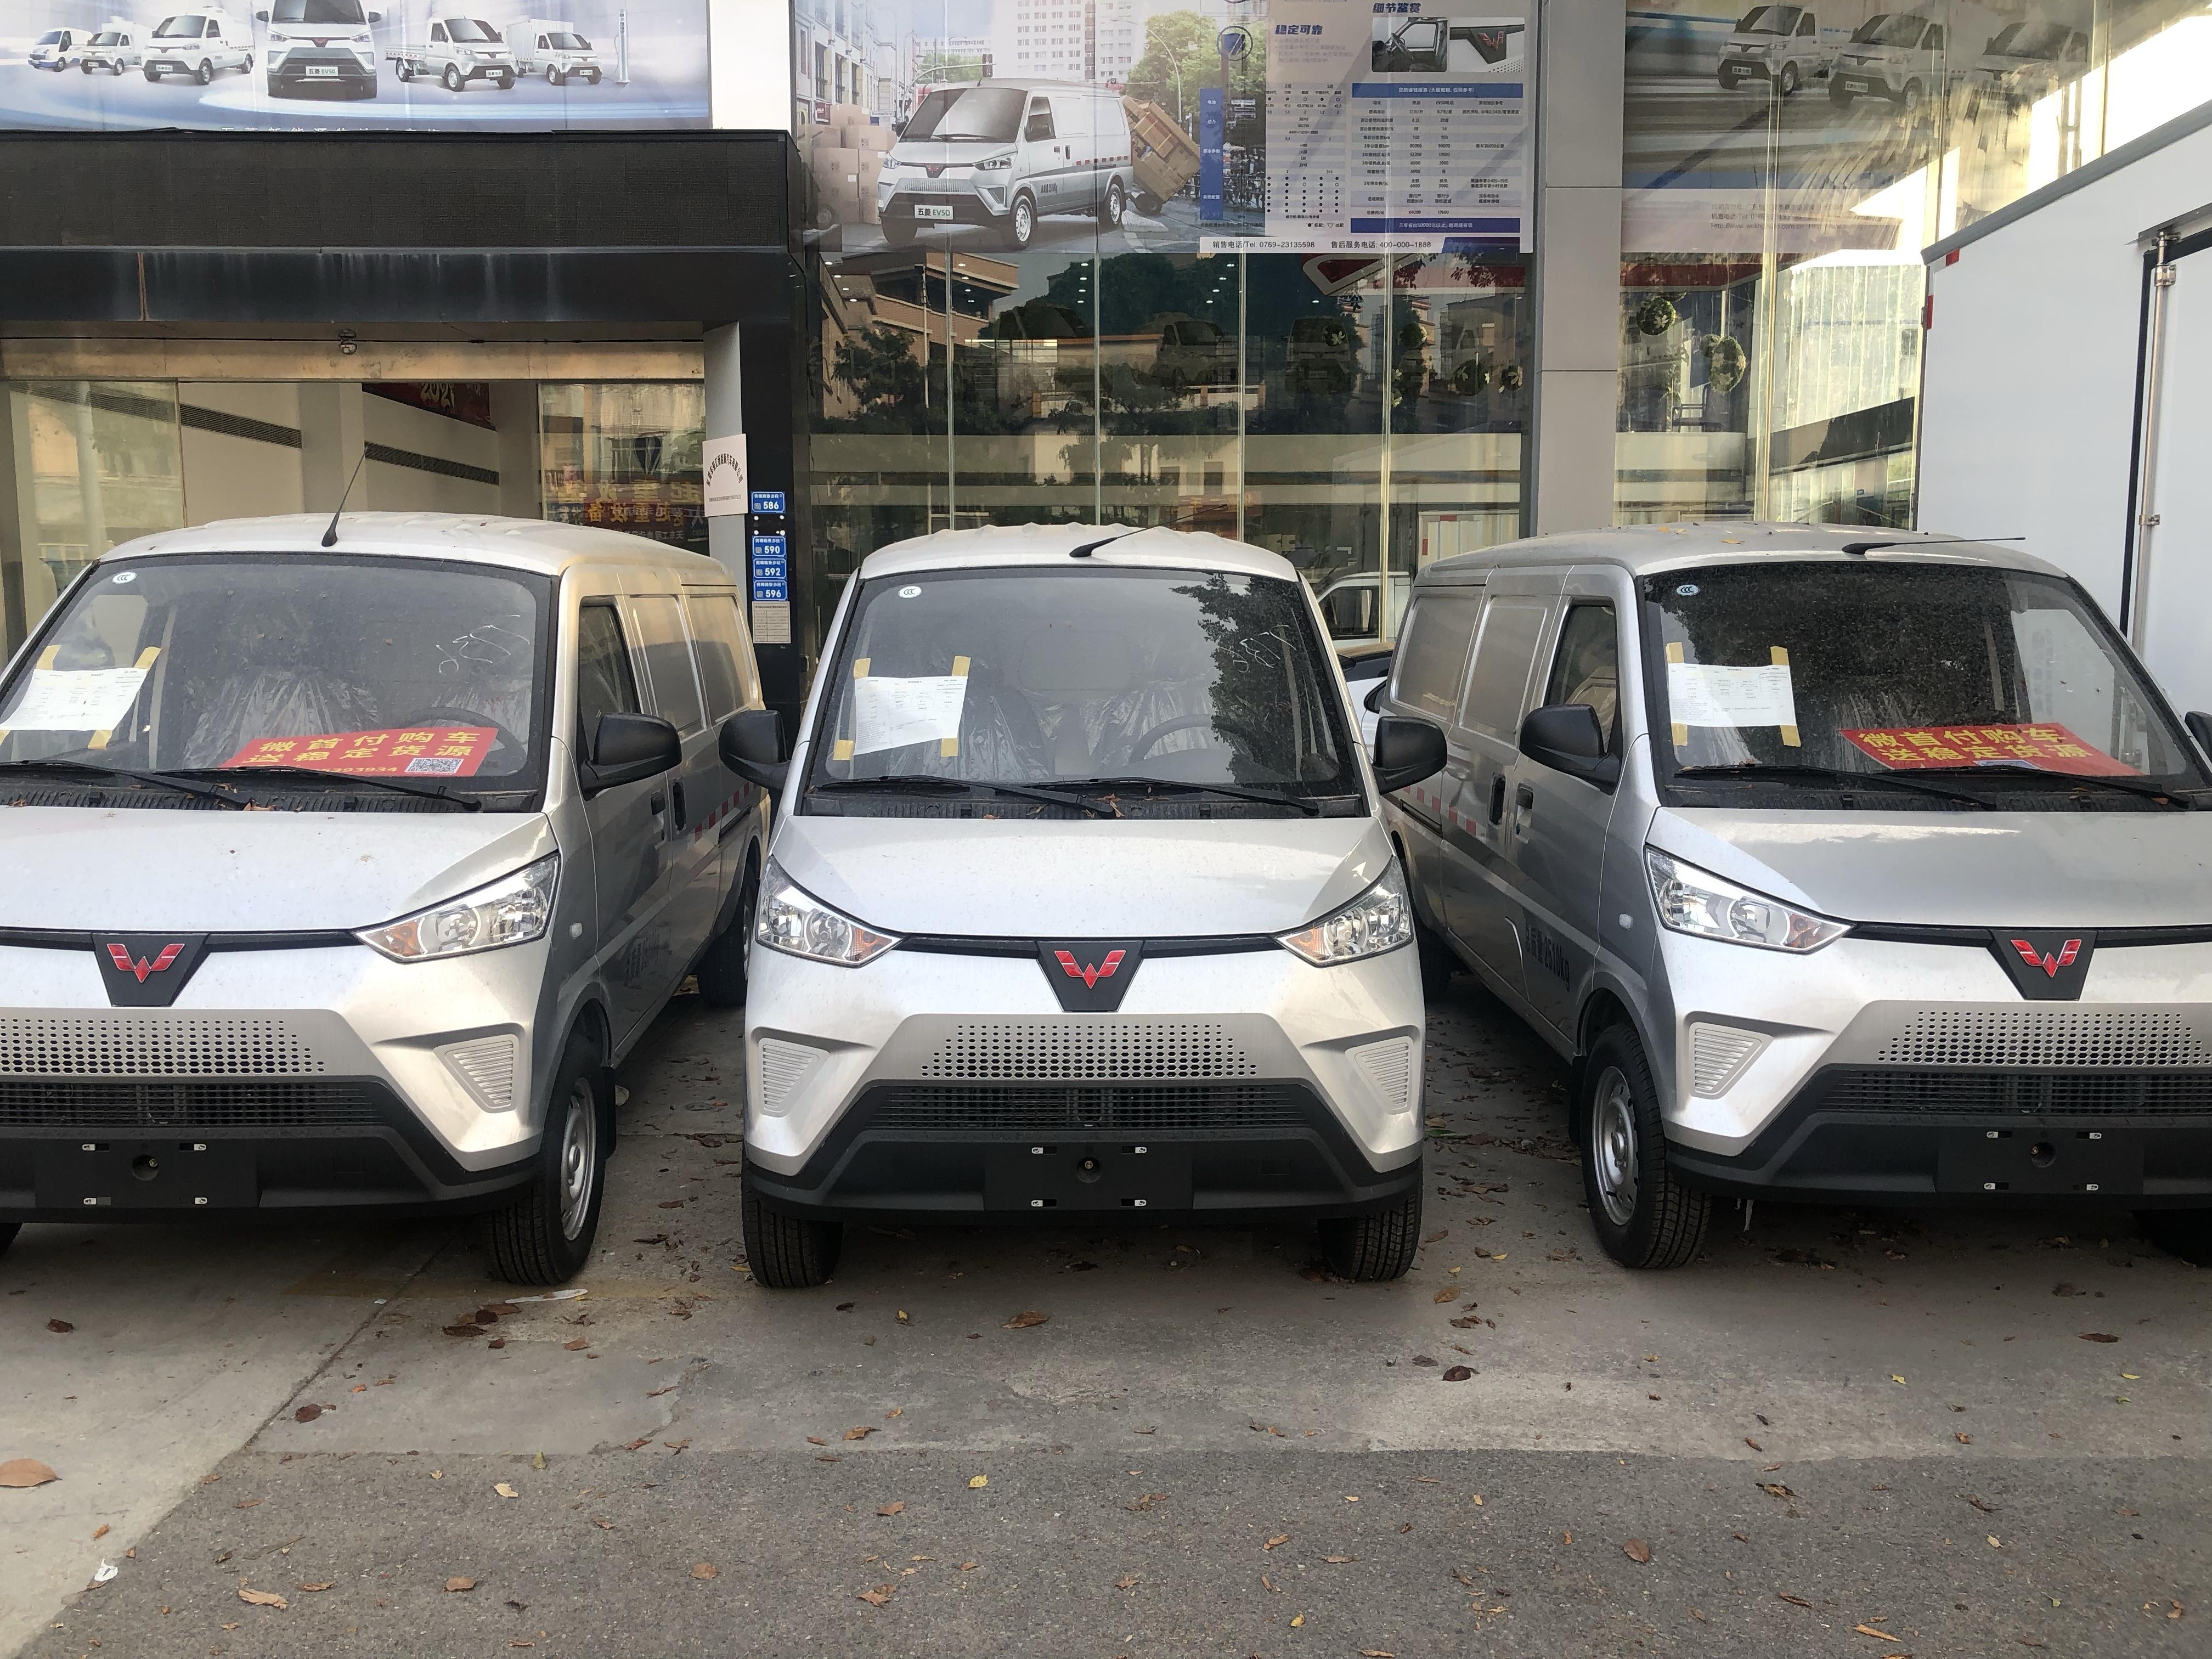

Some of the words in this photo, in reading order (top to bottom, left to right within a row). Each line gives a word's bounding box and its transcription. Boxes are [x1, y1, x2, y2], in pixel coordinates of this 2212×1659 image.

[1372, 3, 1421, 13] 细节鉴赏
[1275, 25, 1323, 35] 稳定可靠
[763, 501, 779, 510] 586
[764, 545, 780, 554] 590
[765, 568, 781, 576] 592
[765, 590, 782, 598] 596
[258, 731, 481, 752] 微首付购车
[1858, 727, 2068, 748] 微首付购车
[242, 745, 475, 764] 送稳定货源
[1881, 744, 2094, 761] 送稳定货源
